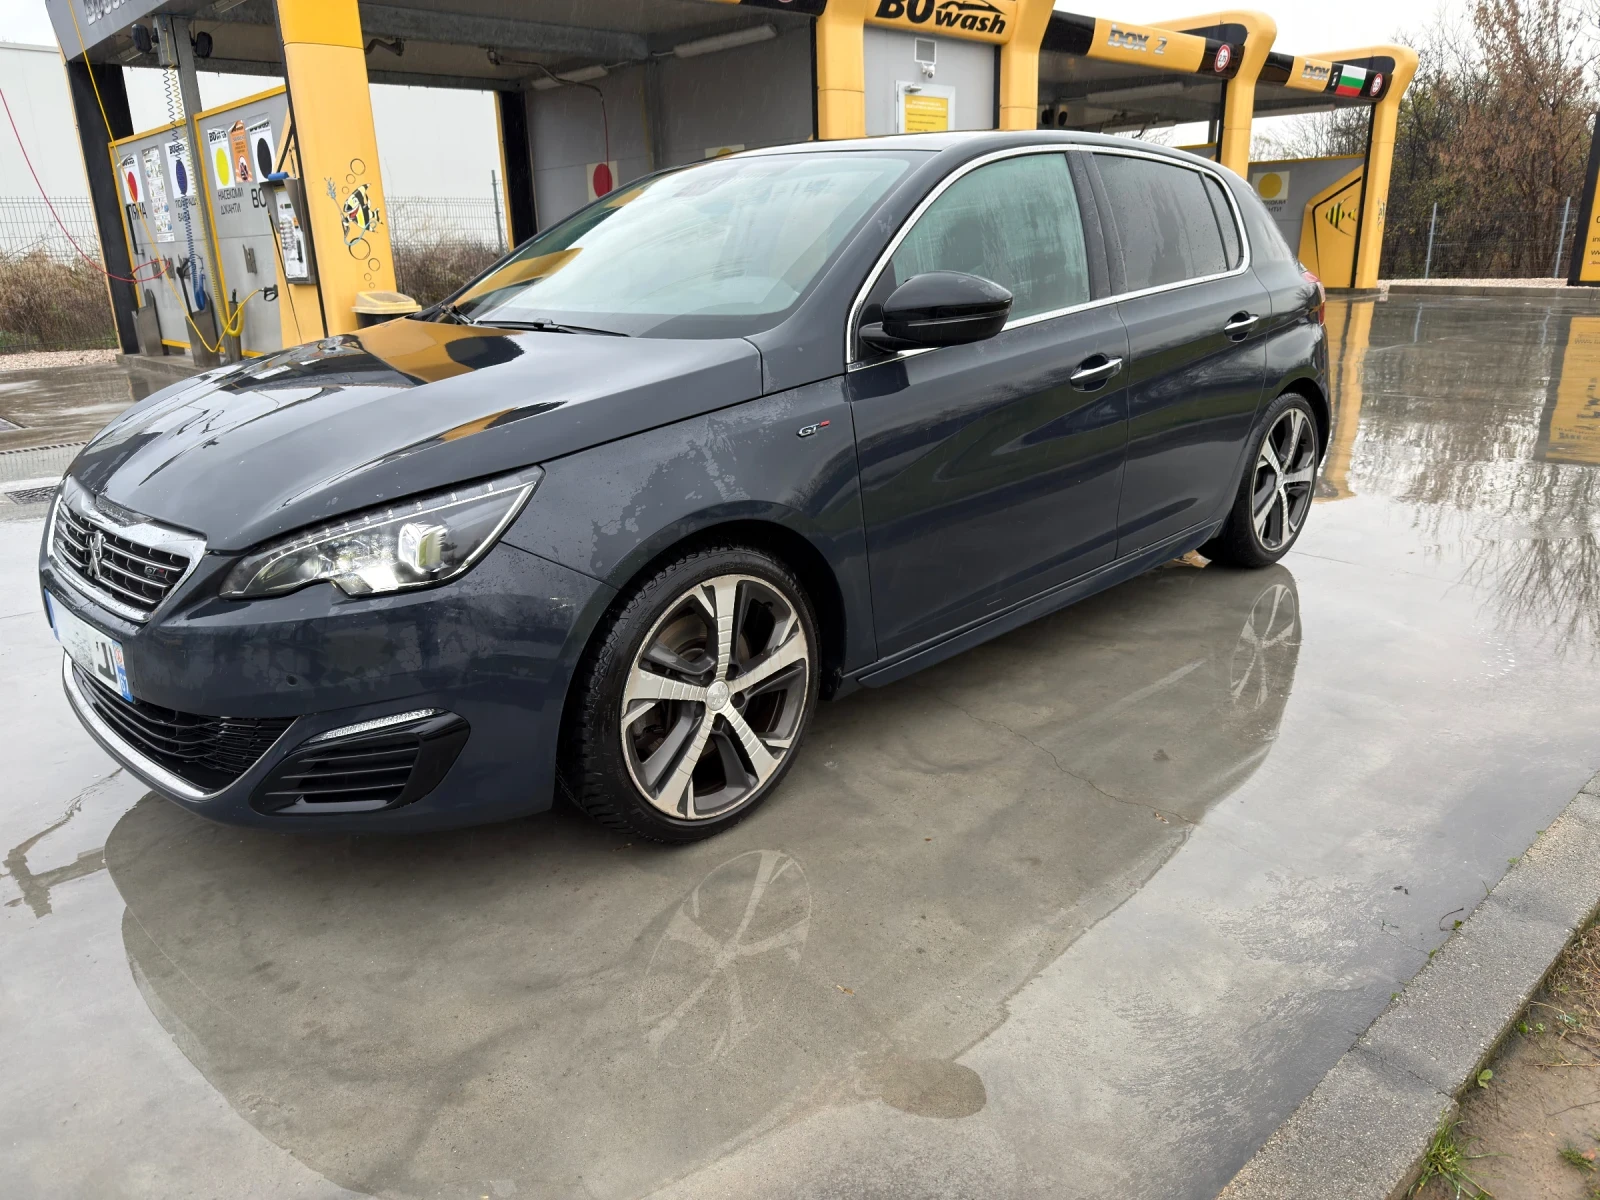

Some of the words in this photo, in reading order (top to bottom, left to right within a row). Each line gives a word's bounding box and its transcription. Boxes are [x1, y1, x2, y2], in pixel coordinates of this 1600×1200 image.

[1107, 22, 1149, 52] box
[1154, 36, 1168, 55] 2
[1331, 71, 1338, 87] 1
[798, 422, 820, 437] GT
